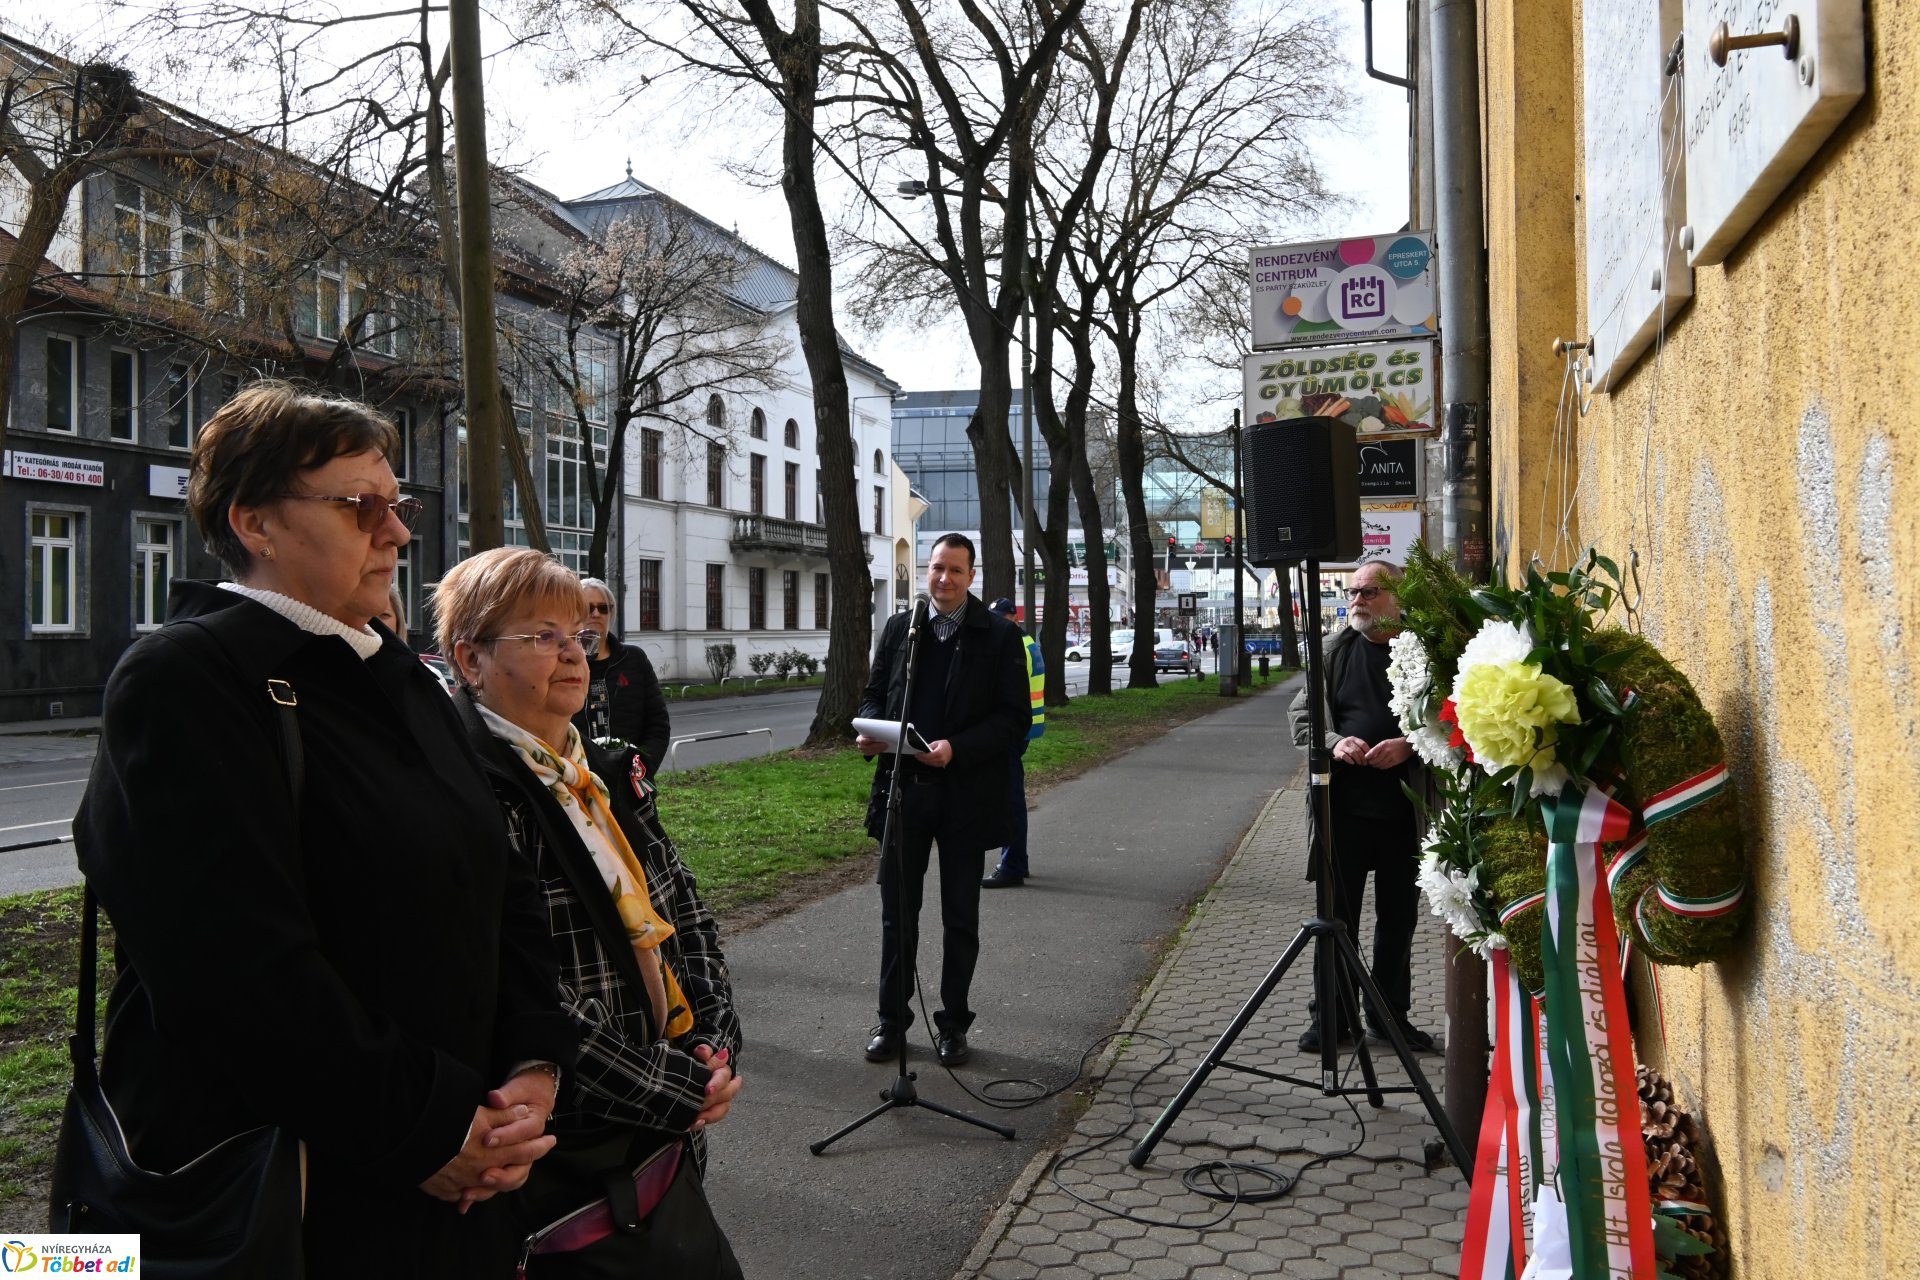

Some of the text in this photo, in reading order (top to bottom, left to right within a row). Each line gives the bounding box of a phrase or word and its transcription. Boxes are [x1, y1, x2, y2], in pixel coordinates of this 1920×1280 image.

[1255, 249, 1338, 268] RENDEZVÉNY
[1388, 250, 1427, 261] EPRESKERT
[1394, 260, 1413, 269] UTCA
[1255, 267, 1318, 283] CENTRUM
[1255, 280, 1328, 293] ÉS PARTY SZAKÜZLET
[1351, 292, 1376, 308] RC
[1290, 326, 1397, 343] www.rendezvenycentrum.com
[1258, 348, 1421, 382] ZÖLDSÉG és
[24, 456, 60, 468] KATEGÓRIÁS
[61, 460, 82, 470] IRODÁK
[83, 463, 103, 473] KIADÓK
[1371, 462, 1404, 475] ANITA
[17, 465, 36, 477] Tel.:
[76, 473, 85, 482] 61
[87, 474, 102, 484] 400
